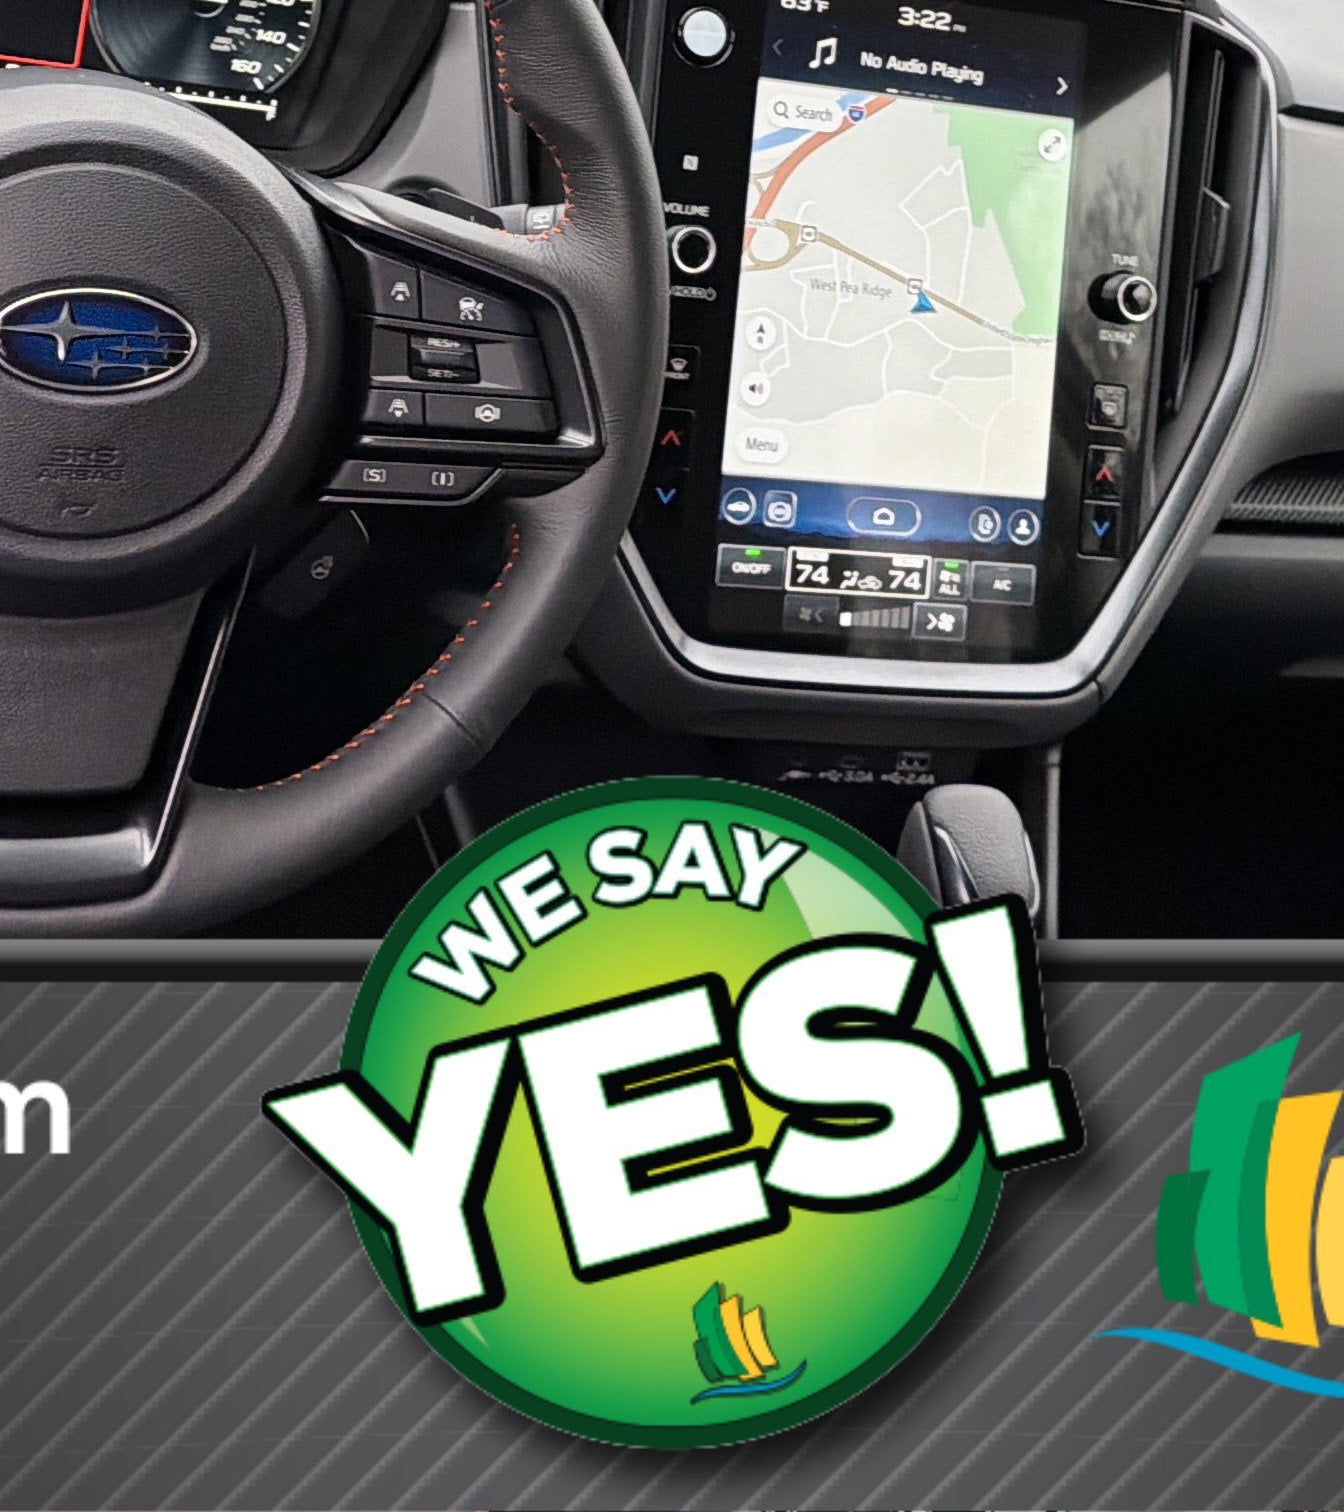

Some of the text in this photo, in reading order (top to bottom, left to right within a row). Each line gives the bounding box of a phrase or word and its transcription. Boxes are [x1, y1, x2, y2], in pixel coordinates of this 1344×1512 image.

[897, 6, 952, 32] 3:22
[256, 28, 287, 44] 140
[230, 58, 262, 75] 160
[860, 51, 985, 86] No Audio Playing
[795, 104, 833, 122] Search
[663, 201, 711, 218] VOLUME
[1111, 253, 1139, 268] TUNE
[809, 277, 838, 291] West
[861, 281, 893, 301] Ridge
[745, 437, 779, 455] Menu
[52, 446, 122, 466] SRS
[38, 467, 126, 483] AIRBAG
[795, 563, 830, 585] 74
[887, 569, 922, 591] 74
